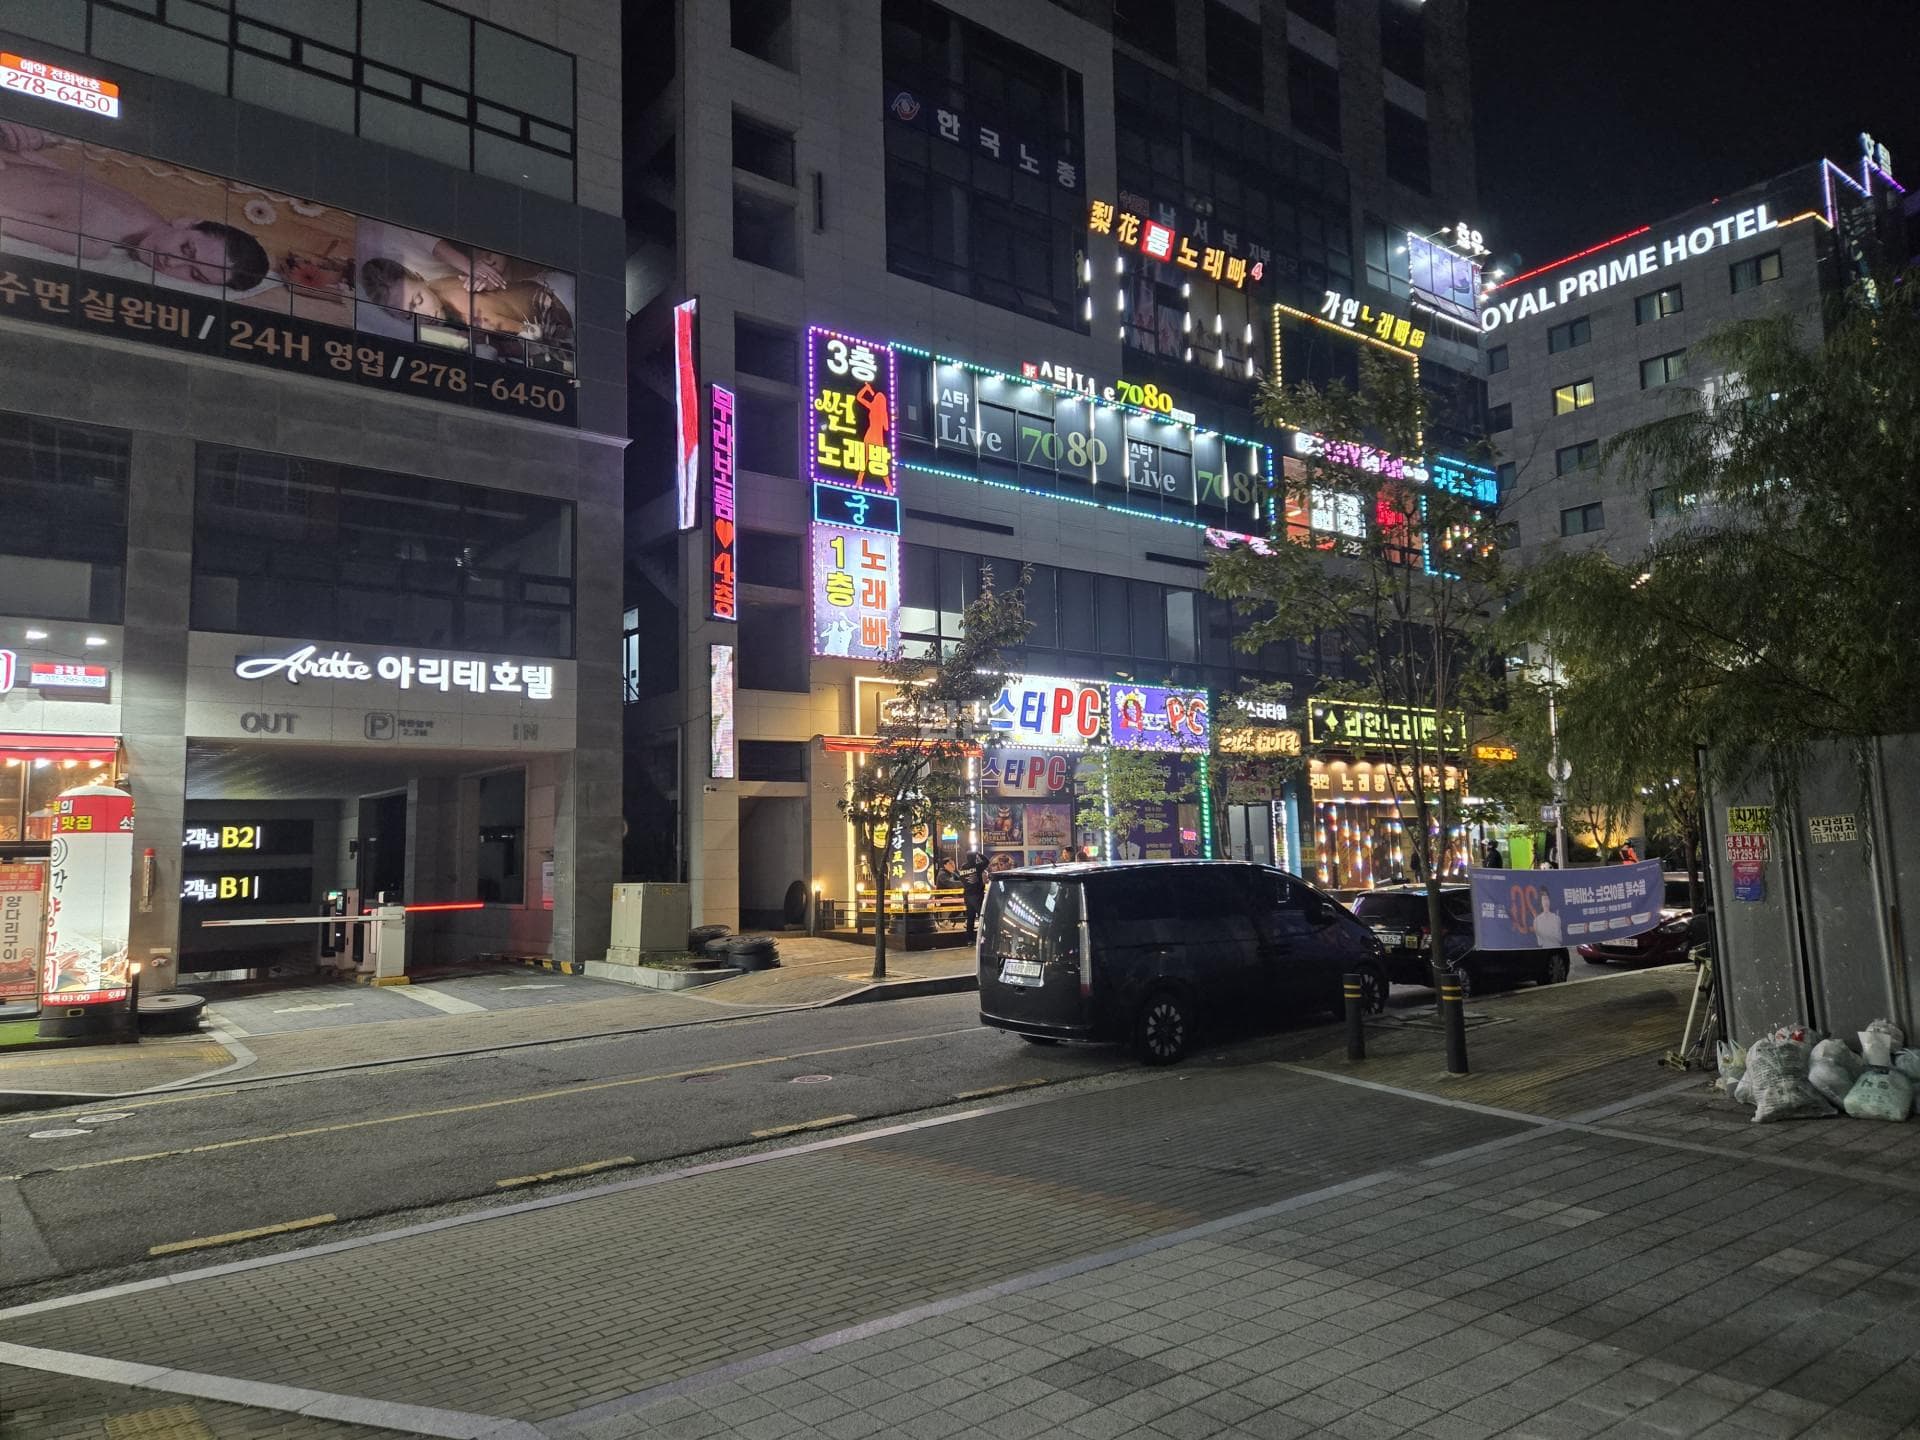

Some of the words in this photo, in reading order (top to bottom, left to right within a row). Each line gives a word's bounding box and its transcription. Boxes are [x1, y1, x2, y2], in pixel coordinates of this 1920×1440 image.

[6, 71, 110, 113] 278-6450
[20, 60, 46, 77] 예약
[51, 68, 101, 90] 전화번호
[1481, 286, 1556, 332] OYAL
[1559, 246, 1658, 305] PRIME
[1663, 204, 1778, 267] HOTEL
[230, 320, 310, 363] 24H
[410, 359, 566, 414] 278-6450
[827, 340, 877, 382] 3층
[814, 389, 857, 434] 썬
[940, 388, 970, 413] 스타
[1117, 380, 1173, 413] 7080
[816, 432, 893, 477] 노래방
[938, 413, 1002, 452] Live
[1021, 426, 1108, 468] 7080
[1130, 442, 1153, 463] 스타
[1128, 459, 1177, 492] Live
[844, 494, 869, 525] 궁
[713, 552, 735, 617] 4층
[826, 535, 856, 607] 1층
[860, 539, 891, 650] 노래빠
[240, 711, 298, 735] OUT
[512, 722, 539, 741] IN
[61, 815, 93, 831] 맛집
[182, 828, 219, 850] 객님
[222, 826, 254, 849] B2
[180, 879, 217, 901] 객님
[220, 877, 249, 899] B1
[3, 896, 21, 960] 양다리구이
